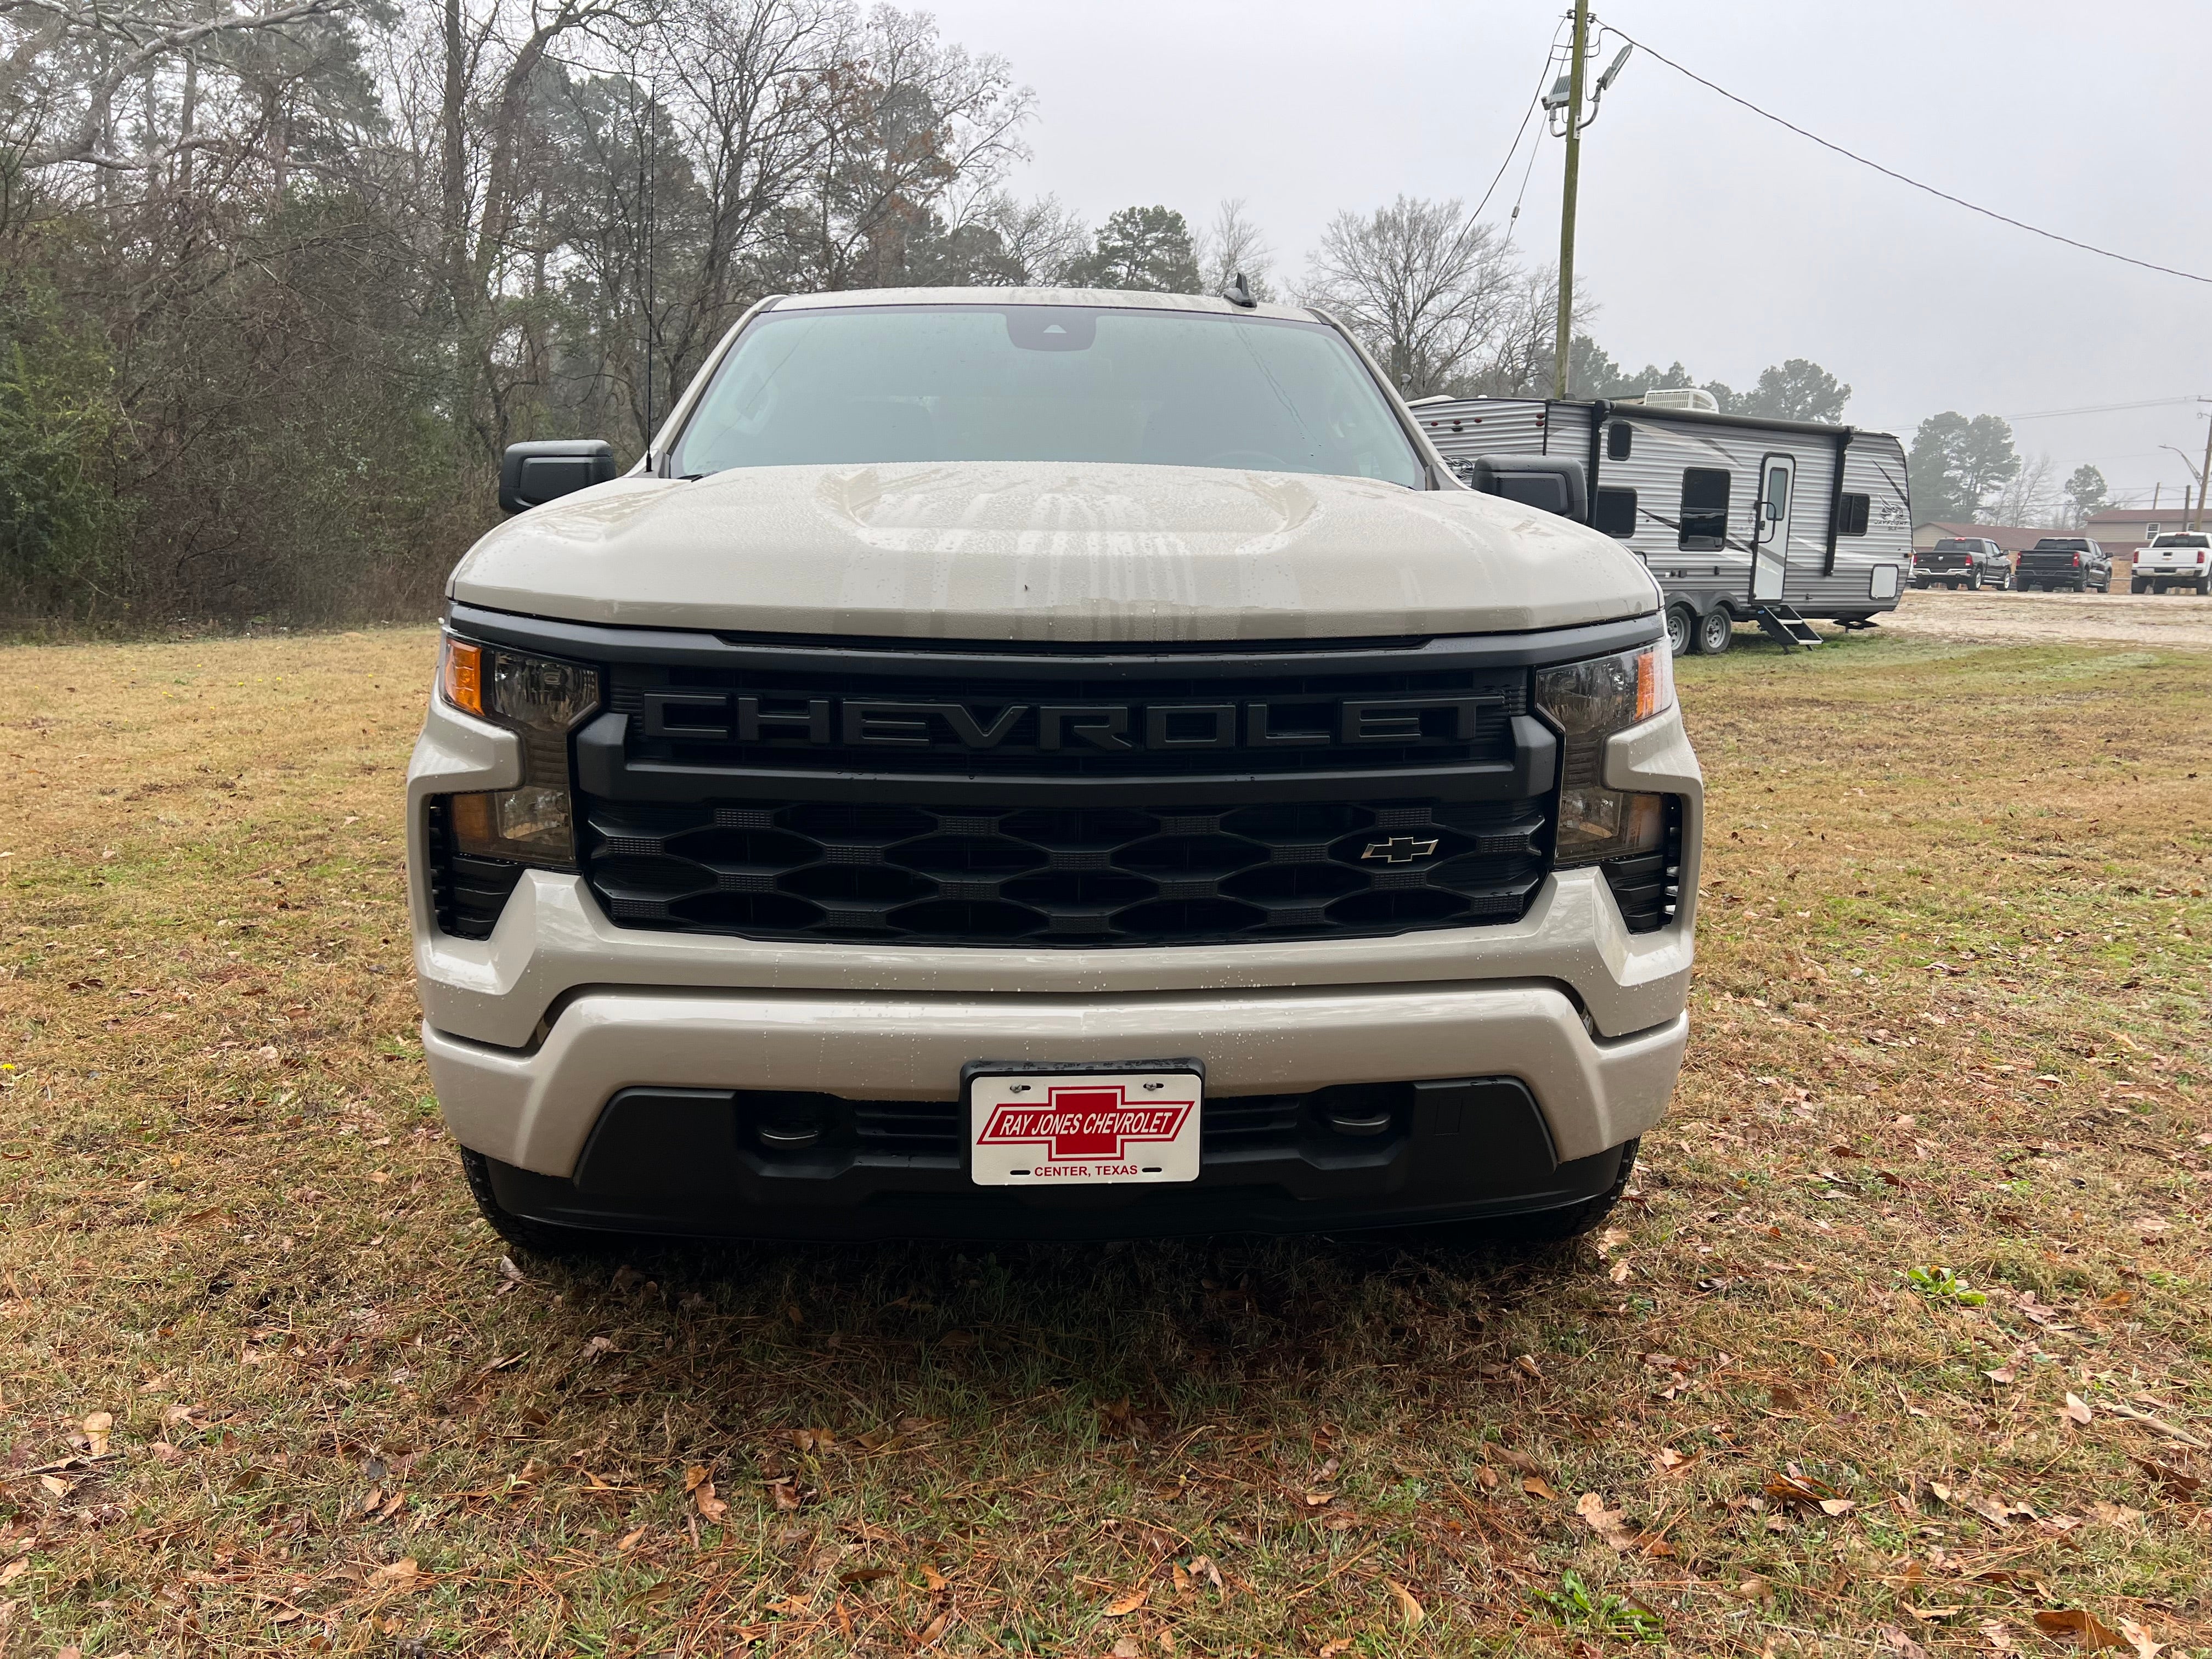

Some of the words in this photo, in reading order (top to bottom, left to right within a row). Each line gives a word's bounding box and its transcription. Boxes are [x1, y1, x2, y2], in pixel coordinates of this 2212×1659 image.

[643, 692, 1506, 752] CHEVROLET
[999, 1114, 1032, 1136] RAY
[1031, 1114, 1082, 1136] JONES
[1083, 1112, 1173, 1134] CHEVROLET
[1035, 1166, 1091, 1177] CENTER,
[1095, 1165, 1138, 1176] TEXAS
